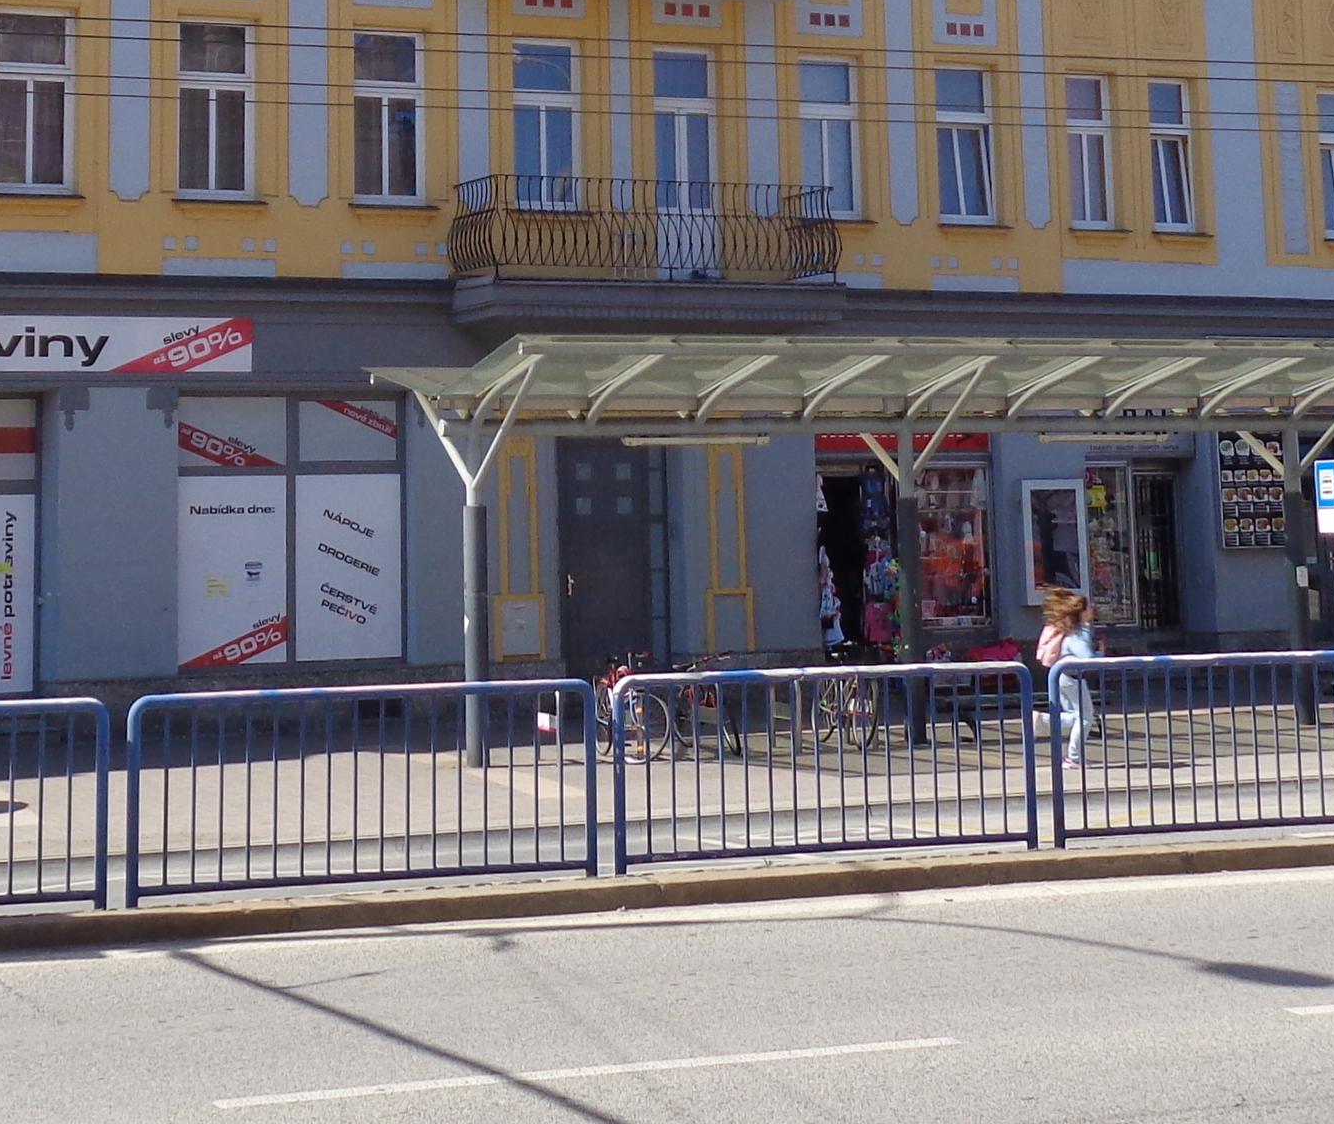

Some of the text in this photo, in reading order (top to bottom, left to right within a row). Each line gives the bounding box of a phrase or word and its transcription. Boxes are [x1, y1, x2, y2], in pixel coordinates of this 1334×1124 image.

[163, 325, 199, 345] slevy
[168, 327, 242, 368] 90%
[190, 431, 245, 467] 90%
[227, 435, 256, 454] slevy
[189, 504, 275, 515] Nabídka dne:
[323, 509, 375, 538] NÁPOJE
[317, 543, 381, 577] DROGERIE
[320, 582, 378, 615] ČERSTVÉ
[321, 599, 367, 625] PEČIVO
[252, 613, 281, 630] slevy
[0, 622, 12, 681] levné
[224, 628, 282, 662] 90%
